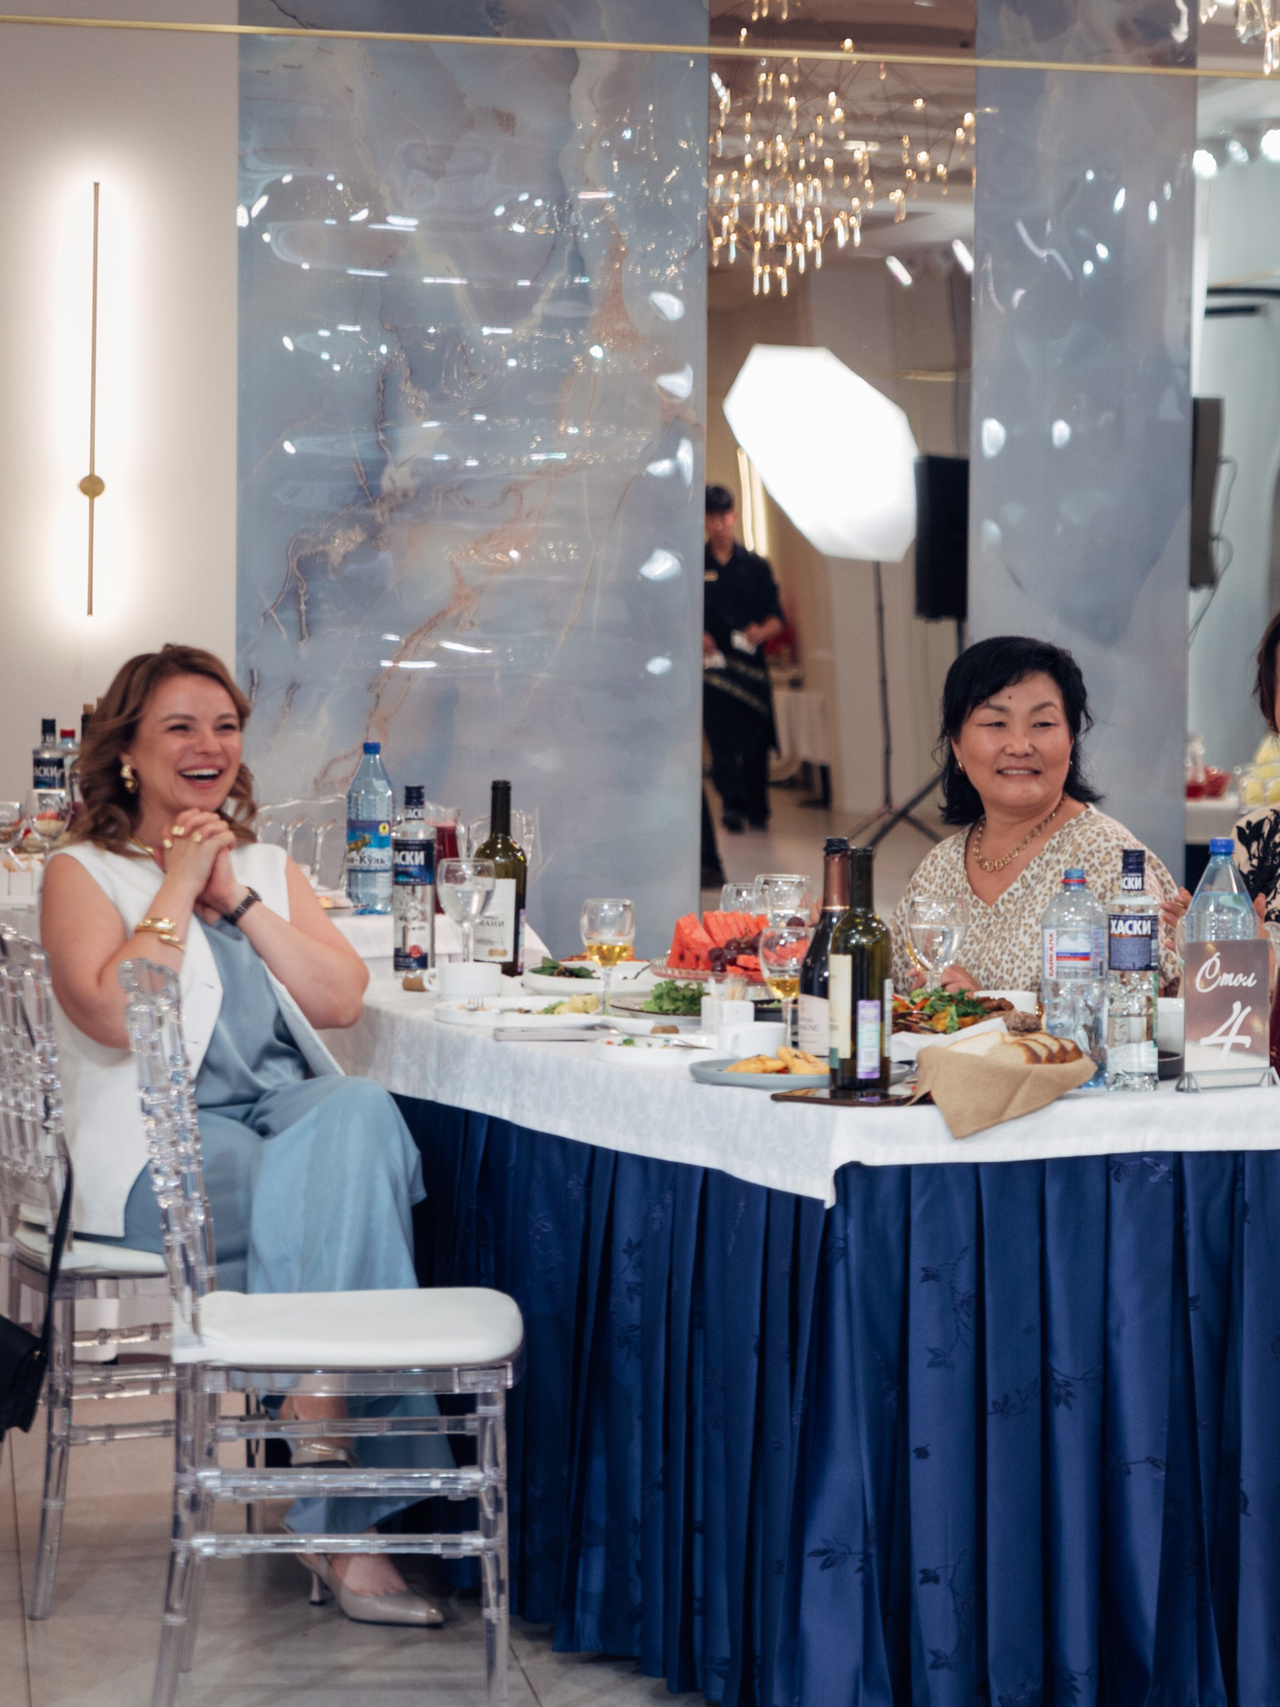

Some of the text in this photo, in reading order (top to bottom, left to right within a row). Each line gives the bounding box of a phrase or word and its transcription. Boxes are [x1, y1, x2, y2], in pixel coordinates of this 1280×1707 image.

[392, 851, 425, 866] АСКИ
[1122, 876, 1142, 890] СКИ
[1110, 919, 1151, 936] ХАСКИ
[1195, 951, 1257, 993] Стол
[1200, 1000, 1251, 1064] 4
